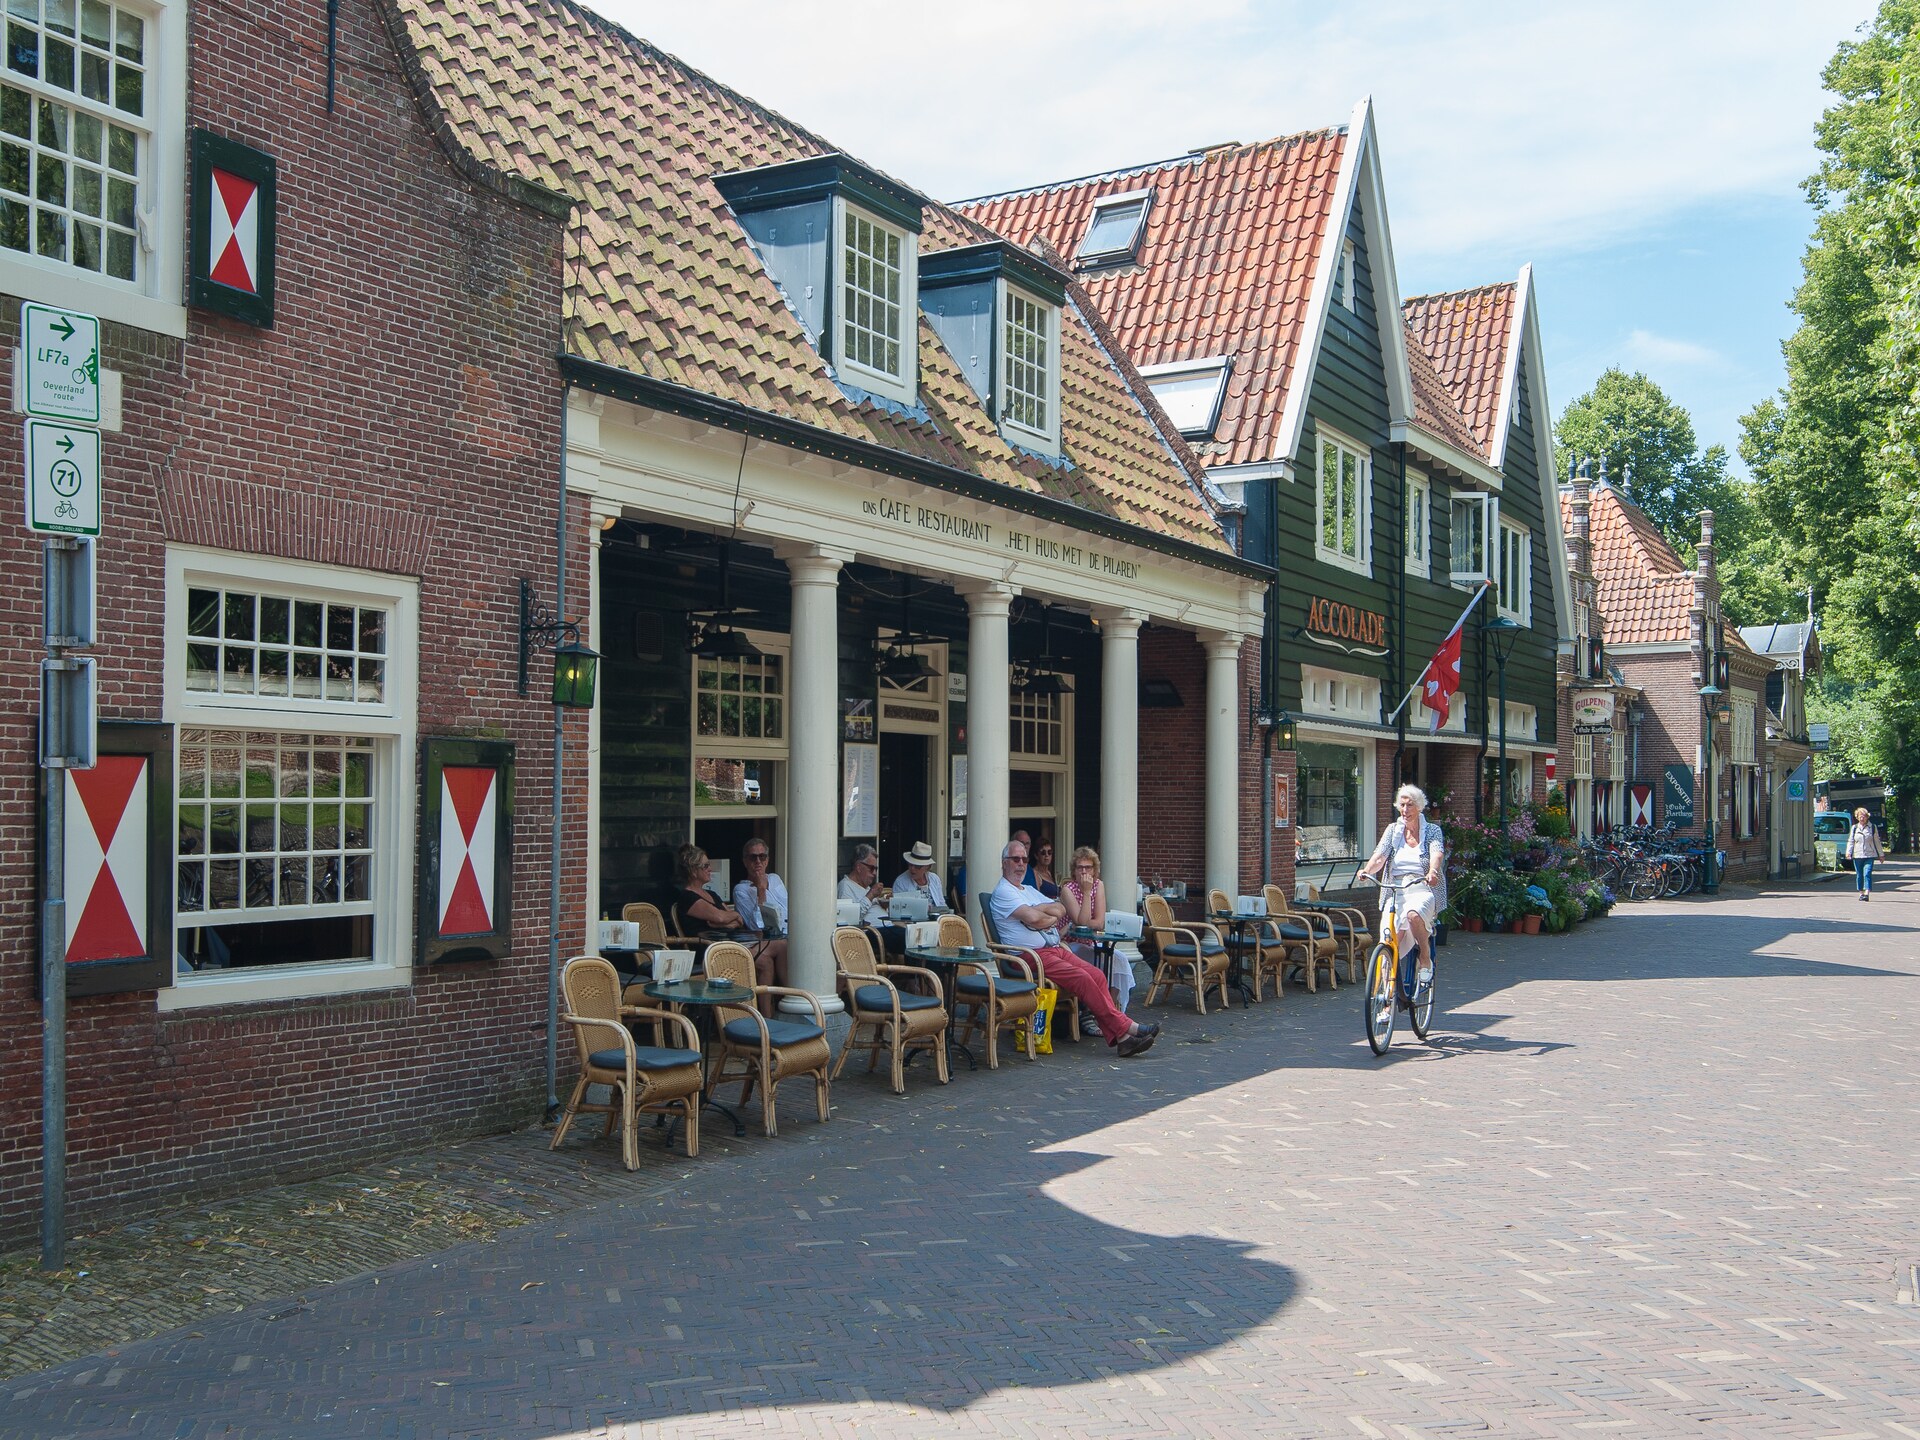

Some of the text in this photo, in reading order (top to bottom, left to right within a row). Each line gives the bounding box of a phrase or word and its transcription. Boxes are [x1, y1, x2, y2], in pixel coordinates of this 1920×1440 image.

[38, 347, 69, 366] LF7a
[43, 381, 85, 395] Oeverland
[53, 393, 75, 402] route
[57, 469, 75, 487] 71
[49, 525, 84, 533] NOORD-HOLLAND
[862, 501, 877, 516] ONS
[880, 498, 911, 523] CAFE
[918, 507, 992, 543] RESTAURANT
[1035, 538, 1059, 560] HUIS
[1062, 544, 1082, 565] MET
[1089, 552, 1100, 571] DE
[1307, 596, 1385, 647] ACCOLADE
[1665, 771, 1693, 806] EXPOSITIE
